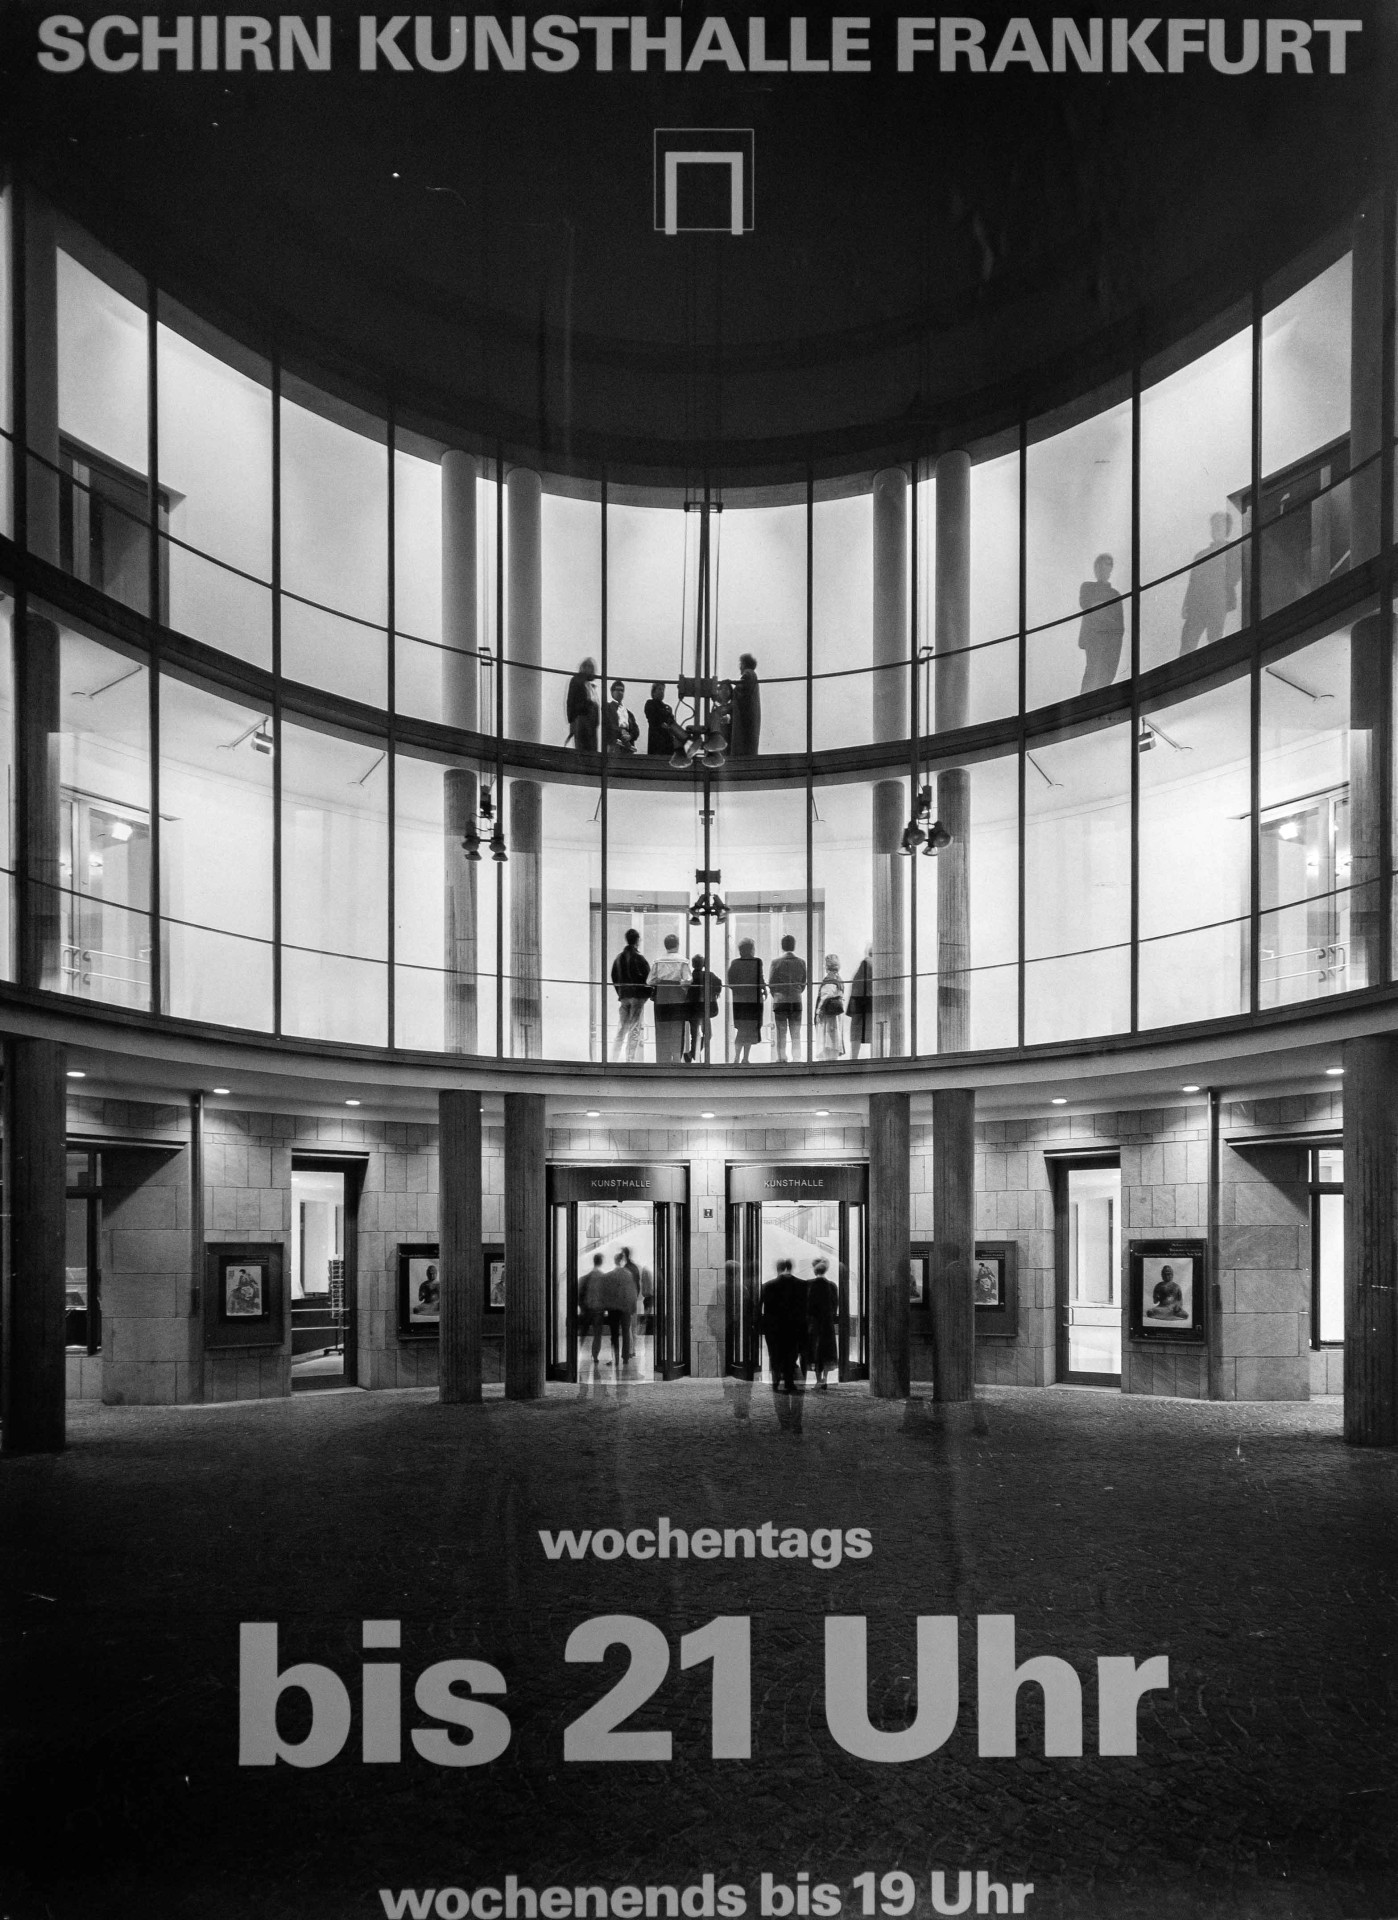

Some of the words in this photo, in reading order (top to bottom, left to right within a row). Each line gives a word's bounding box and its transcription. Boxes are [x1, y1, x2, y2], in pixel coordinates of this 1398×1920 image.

[37, 15, 332, 73] SCHIRN
[359, 14, 872, 73] KUNSTHALLE
[897, 17, 1364, 75] FRANKFURT
[590, 1179, 652, 1189] KUNSTHALLE
[763, 1178, 825, 1189] KUNSTHALLE
[537, 1516, 874, 1570] wochentags
[238, 1619, 512, 1768] bis
[563, 1614, 752, 1762] 21
[824, 1613, 1170, 1763] Uhr
[378, 1873, 748, 1920] wochenends
[760, 1871, 843, 1917] bis
[852, 1870, 916, 1917] 19
[930, 1870, 1035, 1916] Uhr
